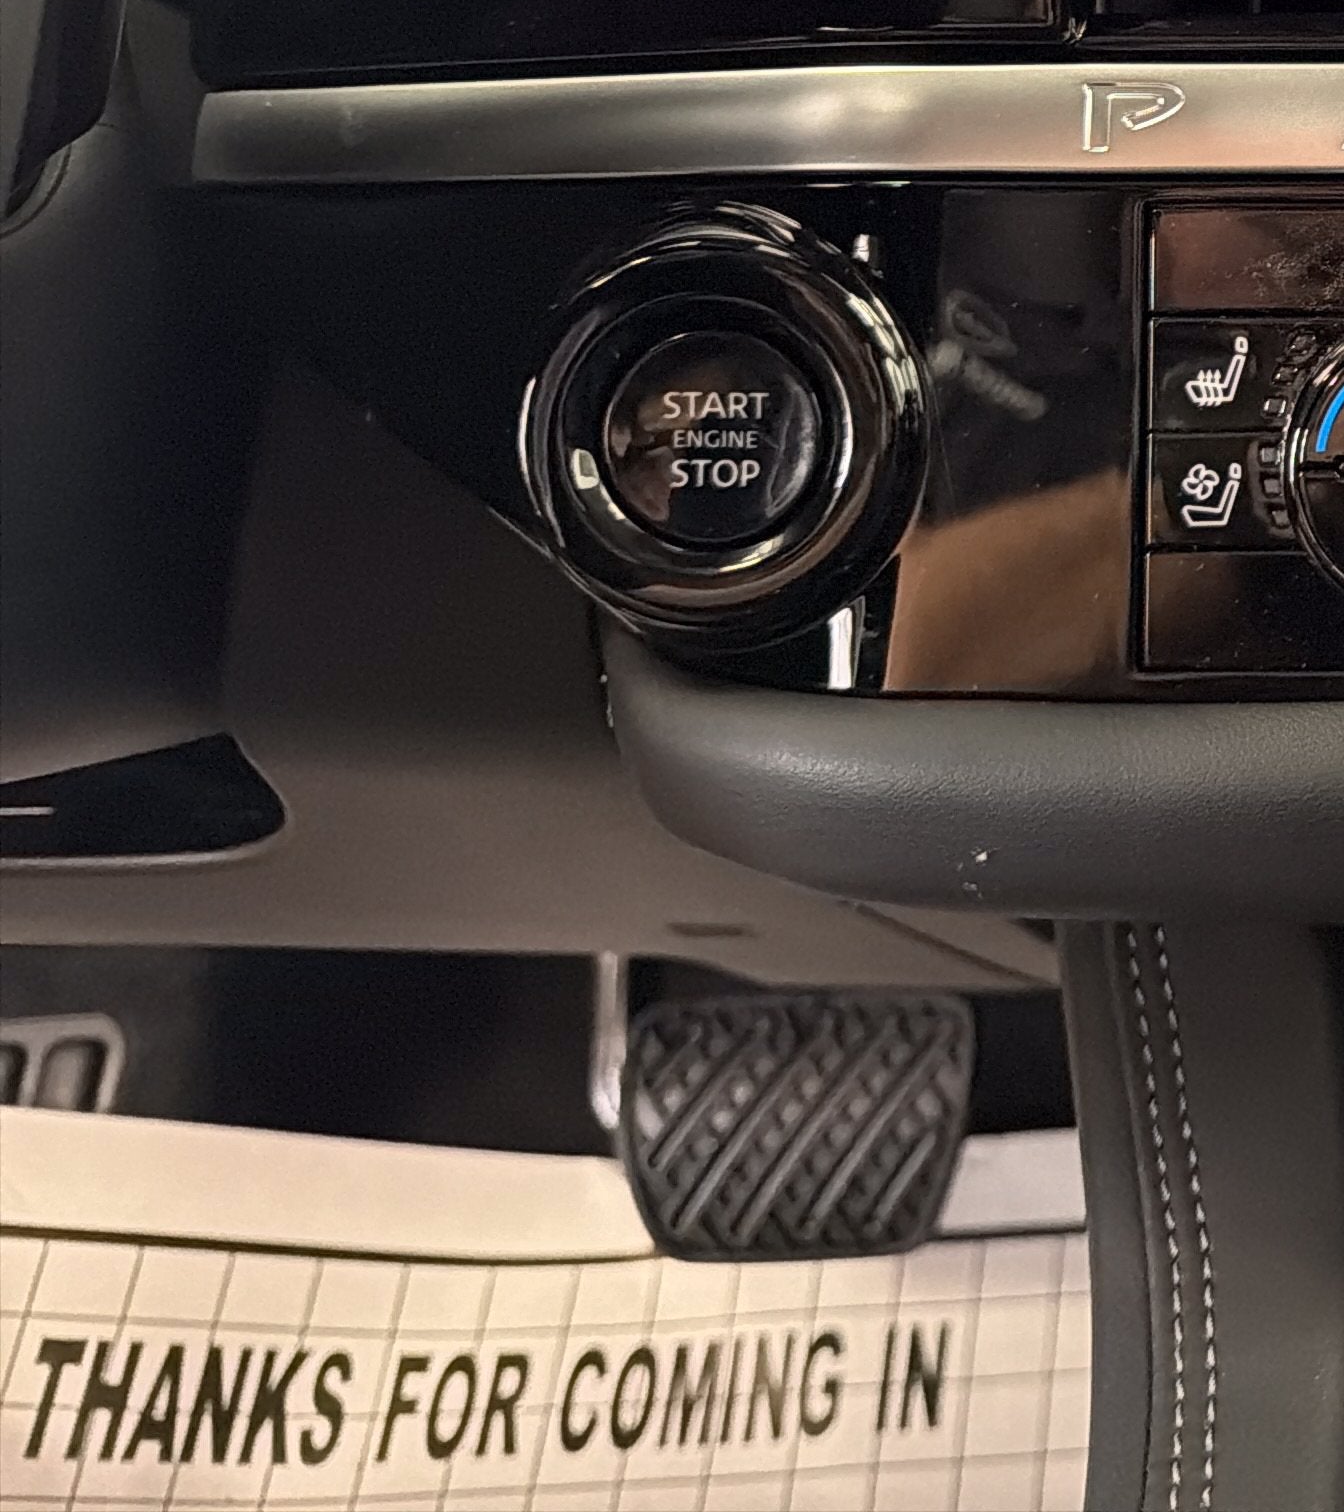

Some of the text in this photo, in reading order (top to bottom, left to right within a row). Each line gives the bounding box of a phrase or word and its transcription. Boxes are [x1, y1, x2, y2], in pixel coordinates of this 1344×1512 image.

[662, 391, 769, 420] START
[673, 429, 758, 449] ENGINE
[669, 458, 761, 488] STOP
[25, 1321, 953, 1465] THANKS FOR COMING IN
